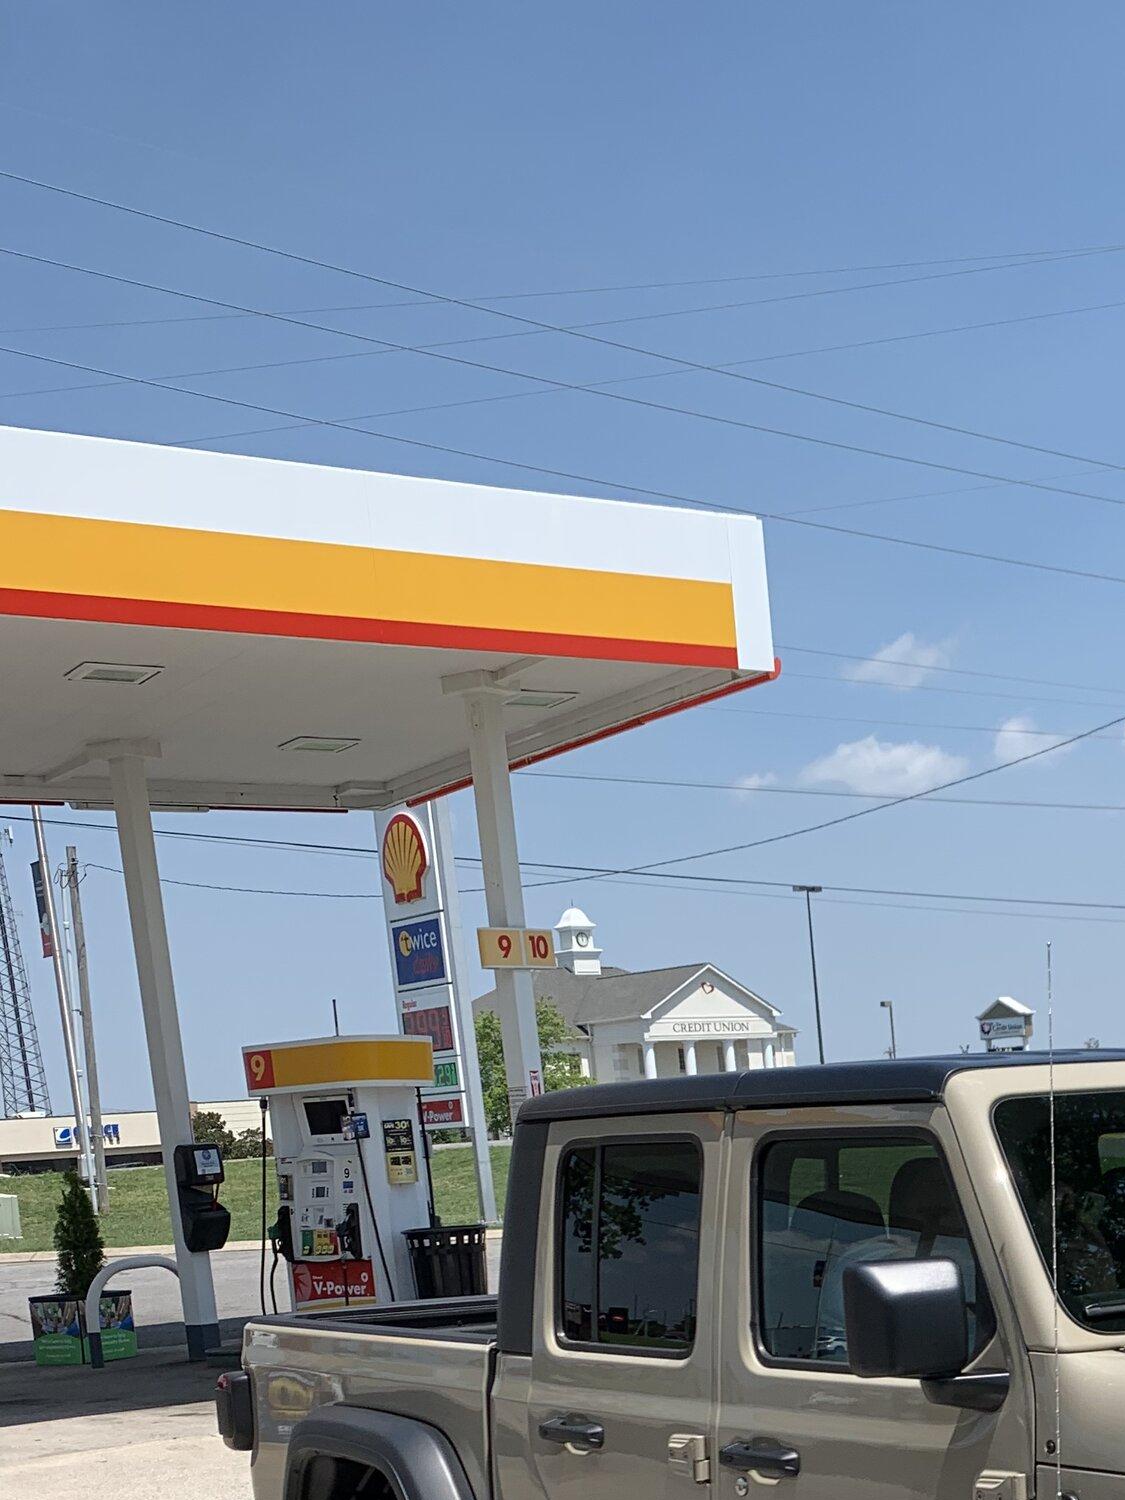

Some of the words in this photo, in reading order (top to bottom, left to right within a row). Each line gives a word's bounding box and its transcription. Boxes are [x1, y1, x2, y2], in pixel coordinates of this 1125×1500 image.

[498, 935, 511, 958] 9
[529, 935, 548, 959] 10
[673, 1023, 712, 1033] CREDIT
[713, 1022, 749, 1032] UNION
[250, 1055, 265, 1081] 9
[344, 1168, 350, 1178] 9
[313, 1281, 366, 1296] V-Power
